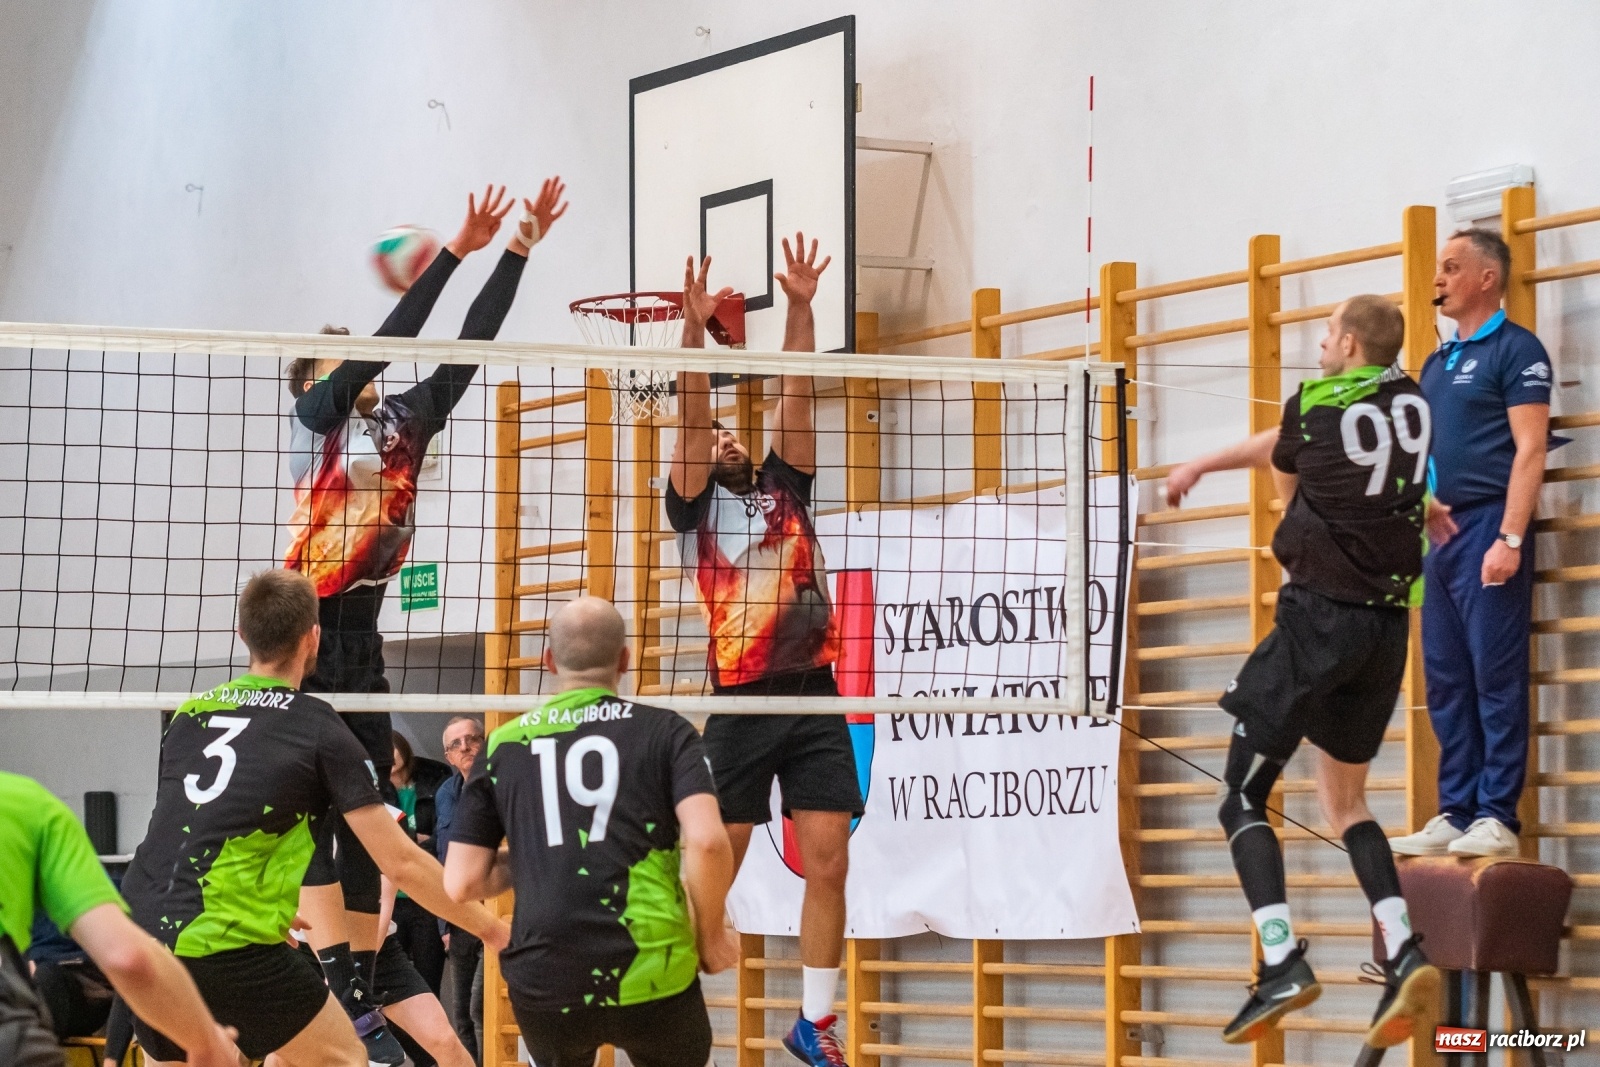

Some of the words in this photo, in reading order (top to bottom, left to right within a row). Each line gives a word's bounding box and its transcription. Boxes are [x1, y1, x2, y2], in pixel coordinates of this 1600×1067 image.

[1340, 393, 1431, 496] 99
[883, 579, 1108, 655] STAROSTWO
[217, 687, 295, 710] RACIBÓRZ
[519, 710, 543, 728] KS
[548, 701, 634, 725] RACIBÓRZ
[183, 715, 252, 804] 3
[530, 735, 620, 847] 19
[889, 776, 916, 822] W
[923, 765, 1108, 820] RACIBORZU
